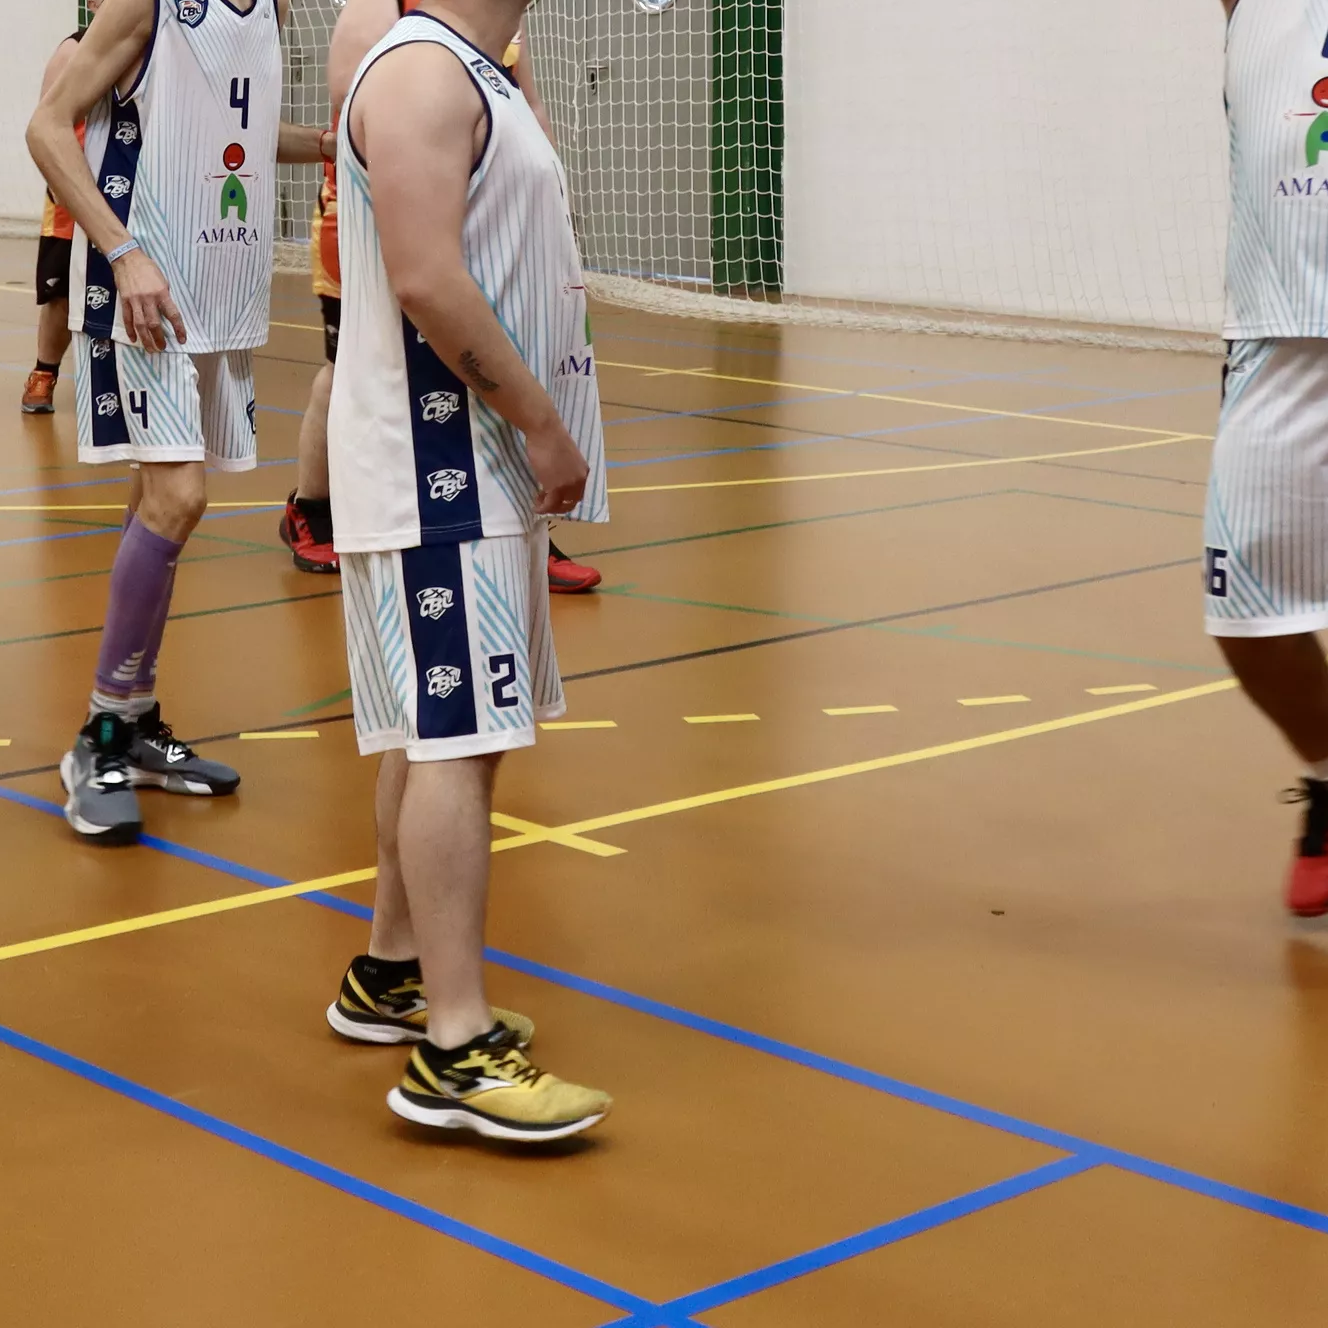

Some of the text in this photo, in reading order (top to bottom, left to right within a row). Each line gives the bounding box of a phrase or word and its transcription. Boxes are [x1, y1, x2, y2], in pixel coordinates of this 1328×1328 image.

[229, 77, 250, 129] 4
[196, 226, 259, 246] AMARA
[128, 390, 148, 429] 4
[489, 653, 518, 708] 2
